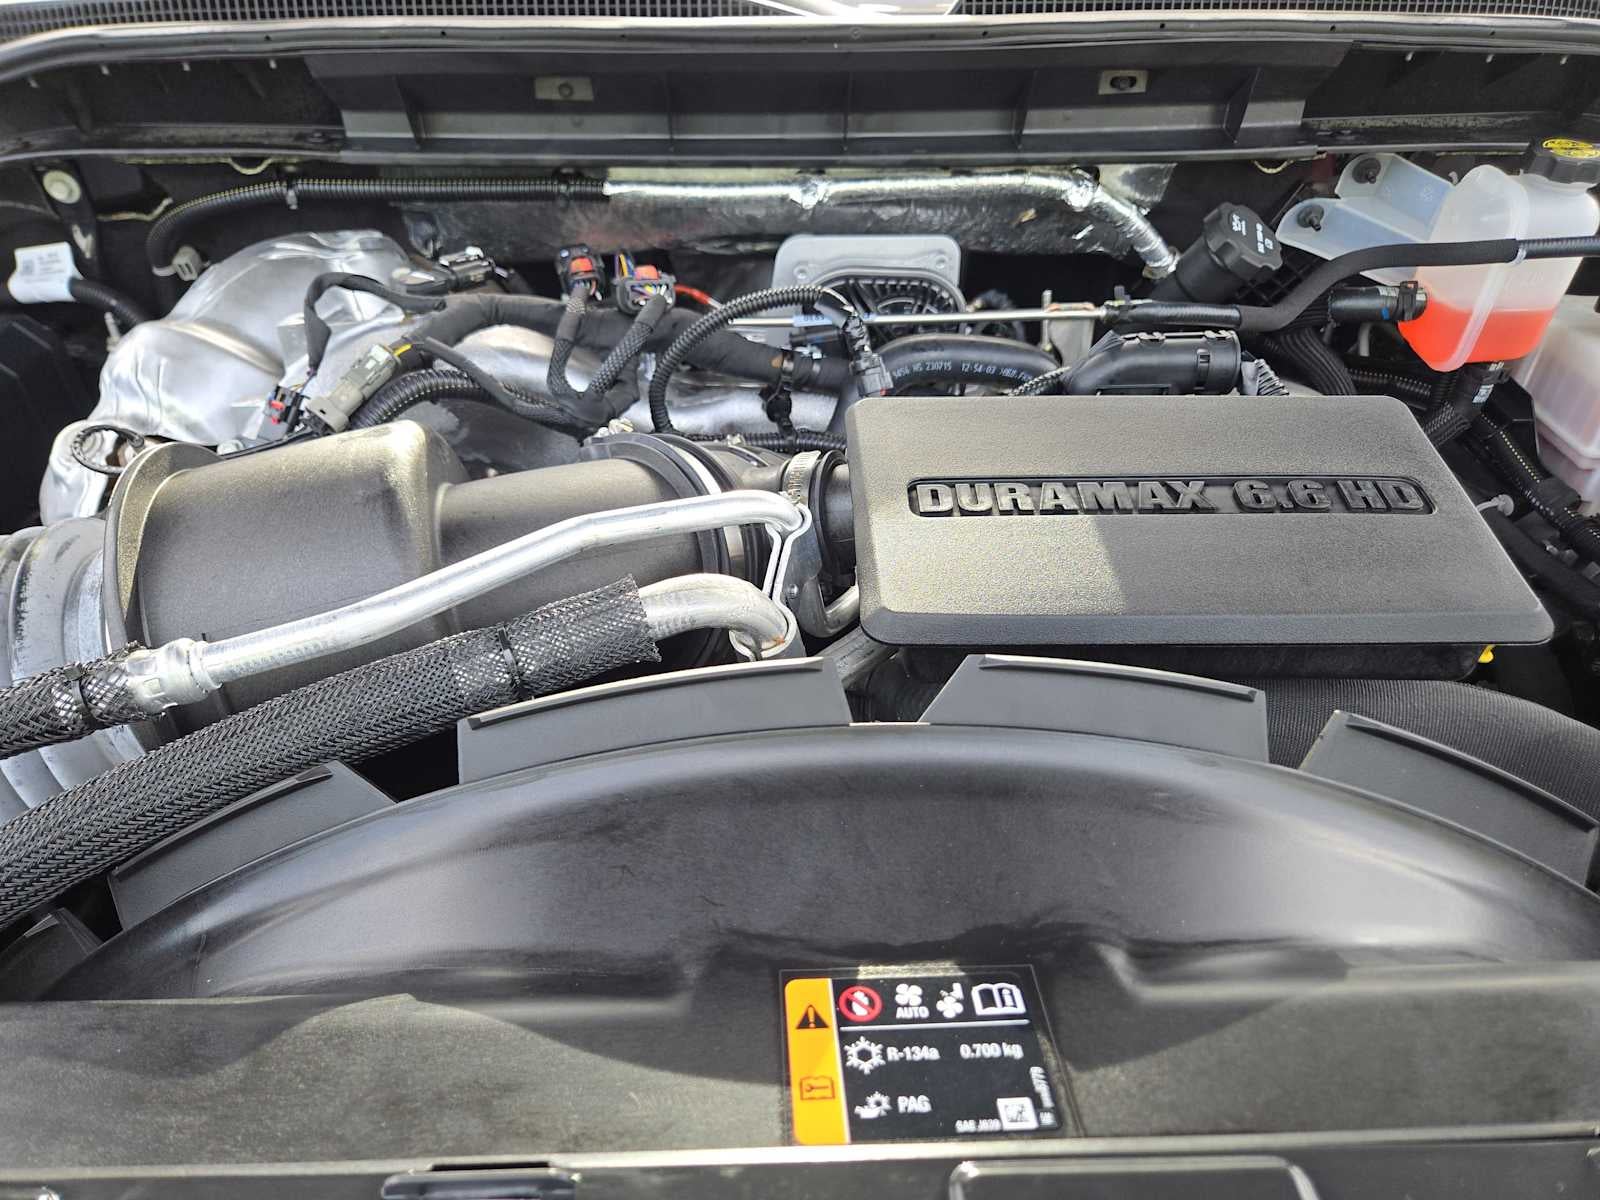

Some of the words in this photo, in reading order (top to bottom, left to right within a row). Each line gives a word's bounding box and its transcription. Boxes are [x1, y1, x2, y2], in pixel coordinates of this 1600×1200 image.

[914, 479, 1216, 514] DURAMAX
[1232, 479, 1331, 512] 6.6
[1334, 478, 1429, 512] HD
[896, 1006, 930, 1019] AUTO
[886, 1046, 941, 1062] R-134a
[959, 1043, 1001, 1059] 0.700
[1002, 1042, 1025, 1060] kg
[897, 1095, 933, 1114] PAG
